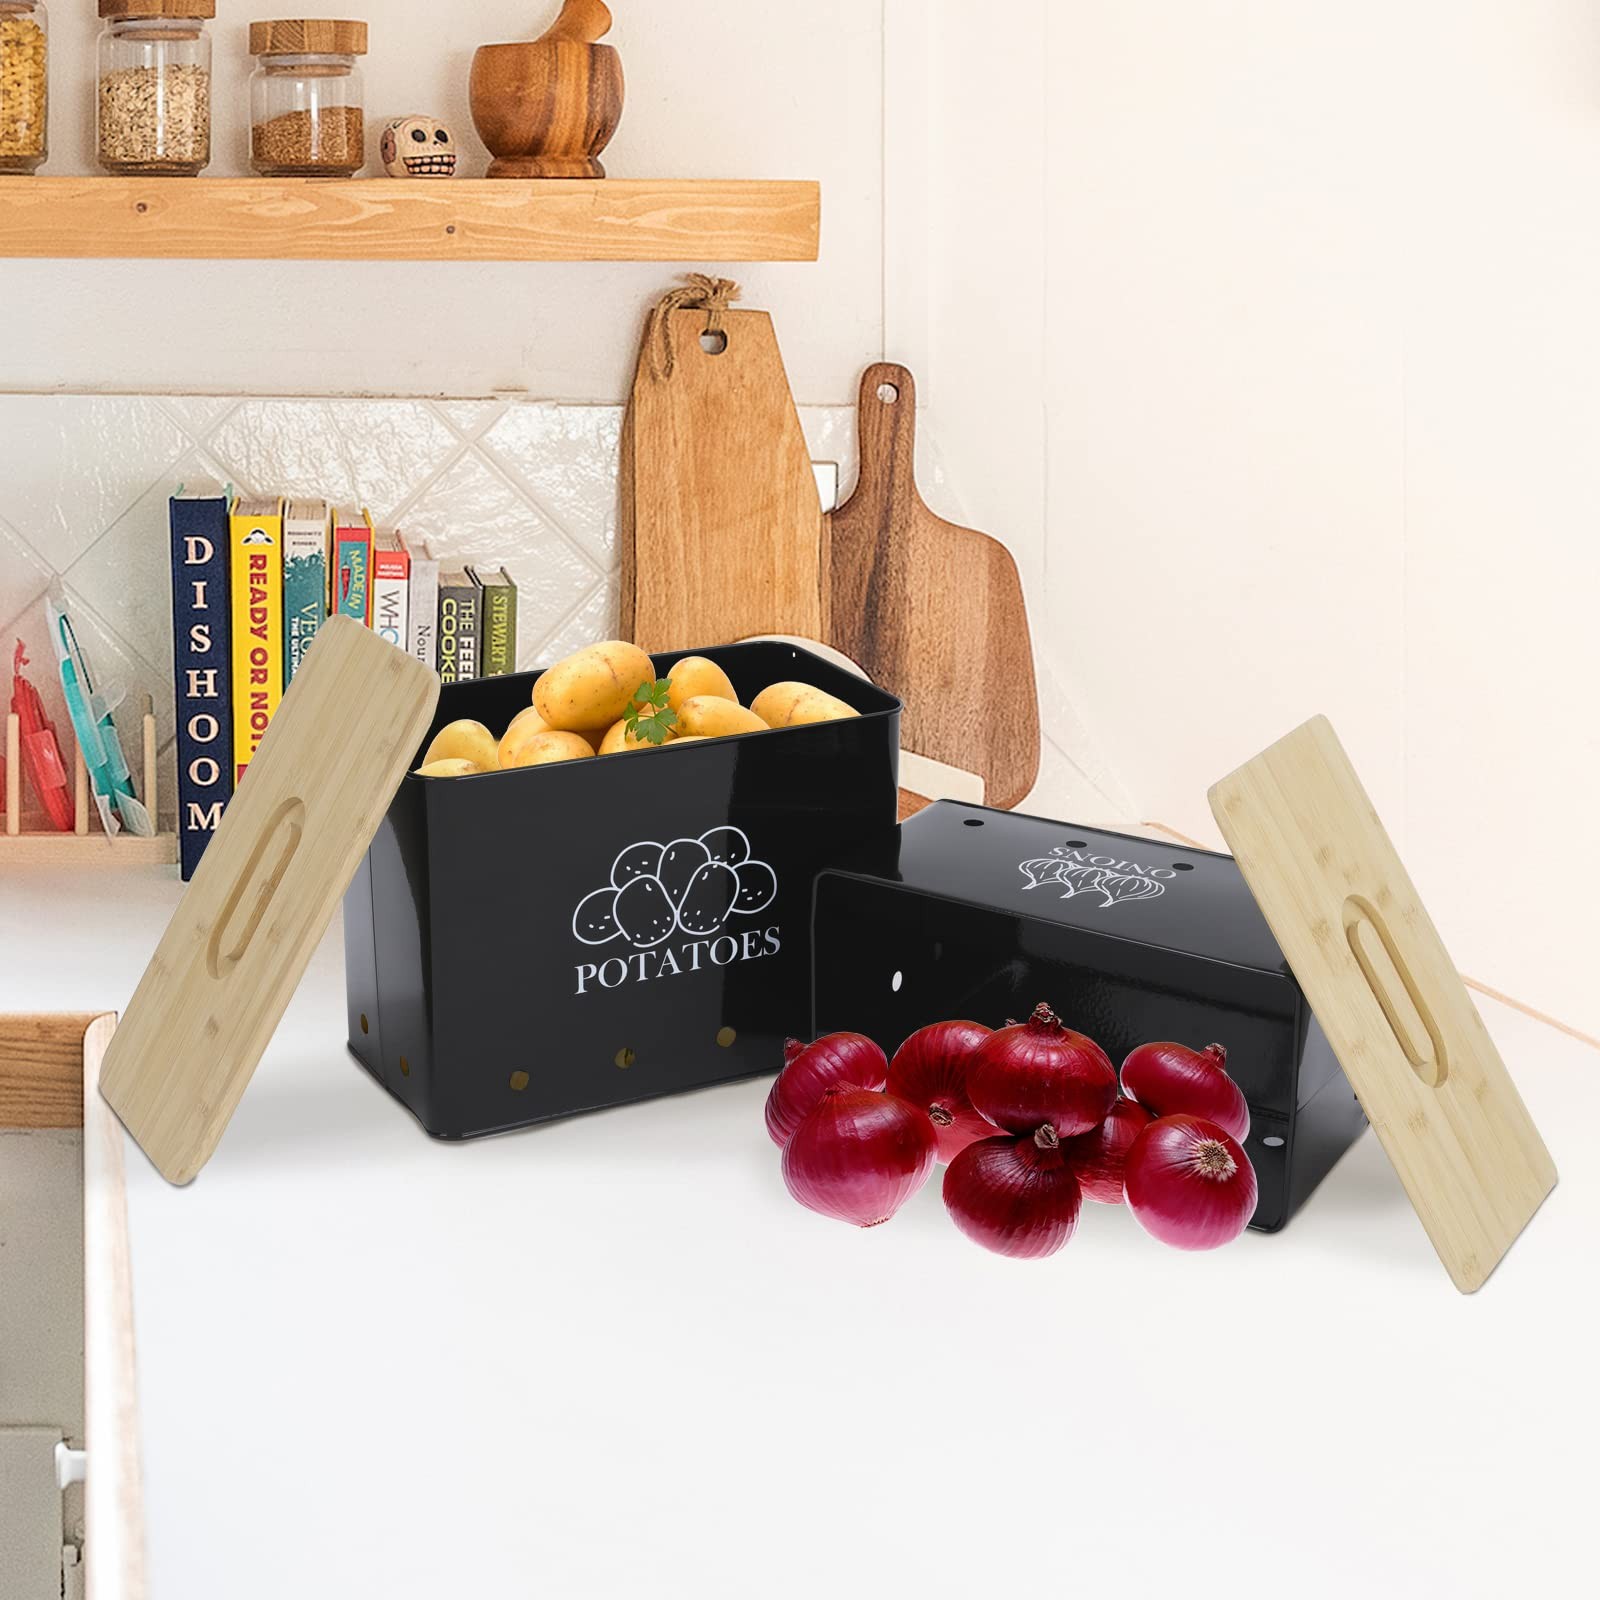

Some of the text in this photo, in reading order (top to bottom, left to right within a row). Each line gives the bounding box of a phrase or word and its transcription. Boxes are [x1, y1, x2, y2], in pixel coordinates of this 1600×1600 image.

[349, 549, 364, 592] MADE
[291, 617, 299, 638] THE
[348, 593, 362, 610] IN
[459, 598, 475, 631] THE
[249, 554, 269, 753] READY OR NOT
[441, 598, 457, 684] COOKE
[491, 595, 508, 666] STEWART
[183, 536, 224, 831] DISHOOM
[1048, 846, 1177, 879] ONIONS
[574, 926, 781, 995] POTATOES
